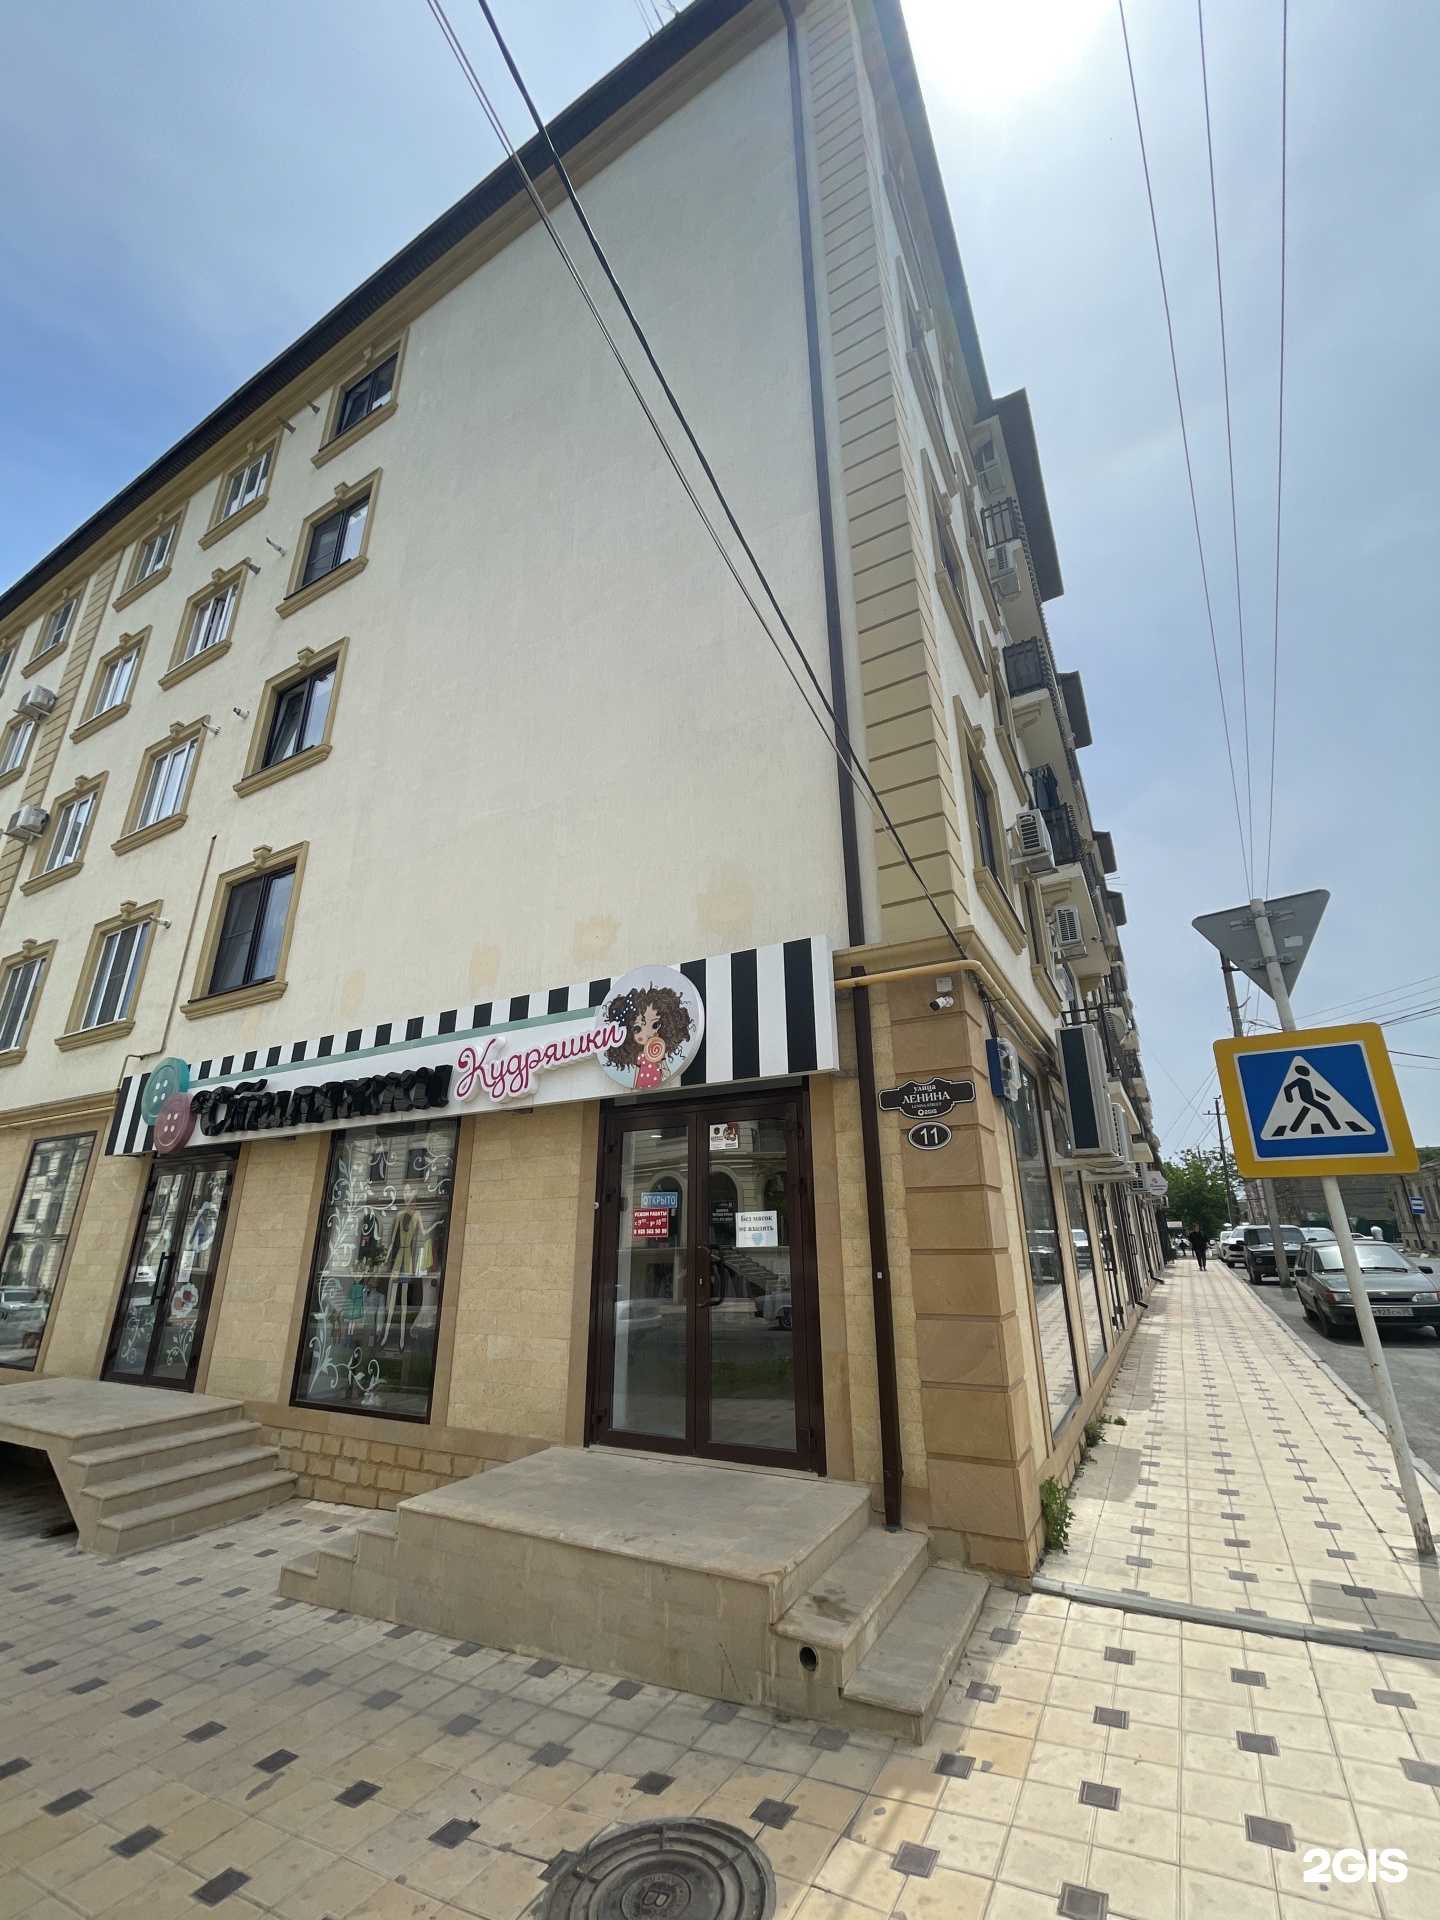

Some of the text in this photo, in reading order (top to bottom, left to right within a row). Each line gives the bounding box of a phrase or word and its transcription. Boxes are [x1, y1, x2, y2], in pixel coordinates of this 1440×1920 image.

[457, 1024, 624, 1098] Кудряшки
[913, 1085, 936, 1093] улица
[902, 1091, 951, 1104] ЛЕНИНА
[920, 1127, 939, 1144] 11
[643, 1195, 676, 1205] ОТКРЫТО
